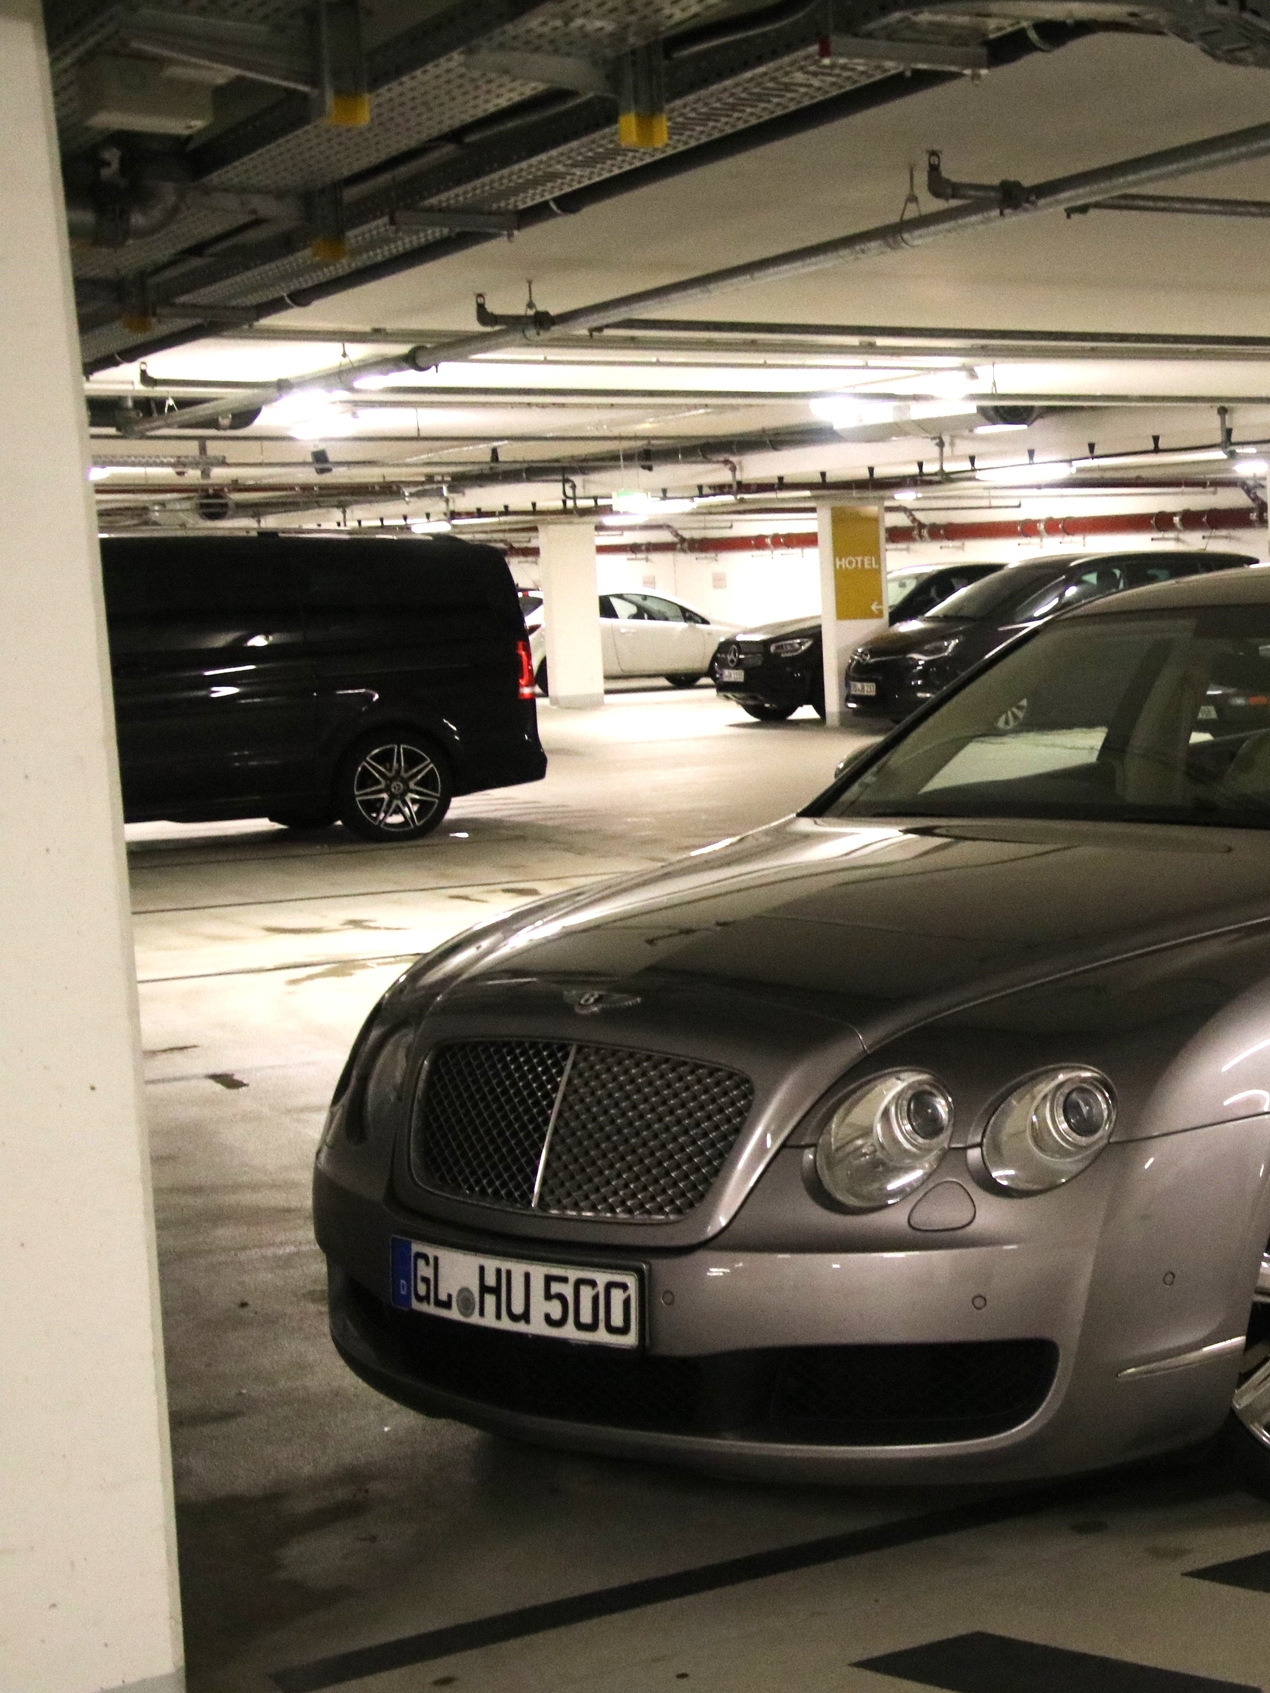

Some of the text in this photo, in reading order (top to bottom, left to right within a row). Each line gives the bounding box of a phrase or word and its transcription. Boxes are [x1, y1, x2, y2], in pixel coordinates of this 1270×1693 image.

[835, 556, 880, 570] HOTEL
[413, 1252, 631, 1335] GL HU 500
